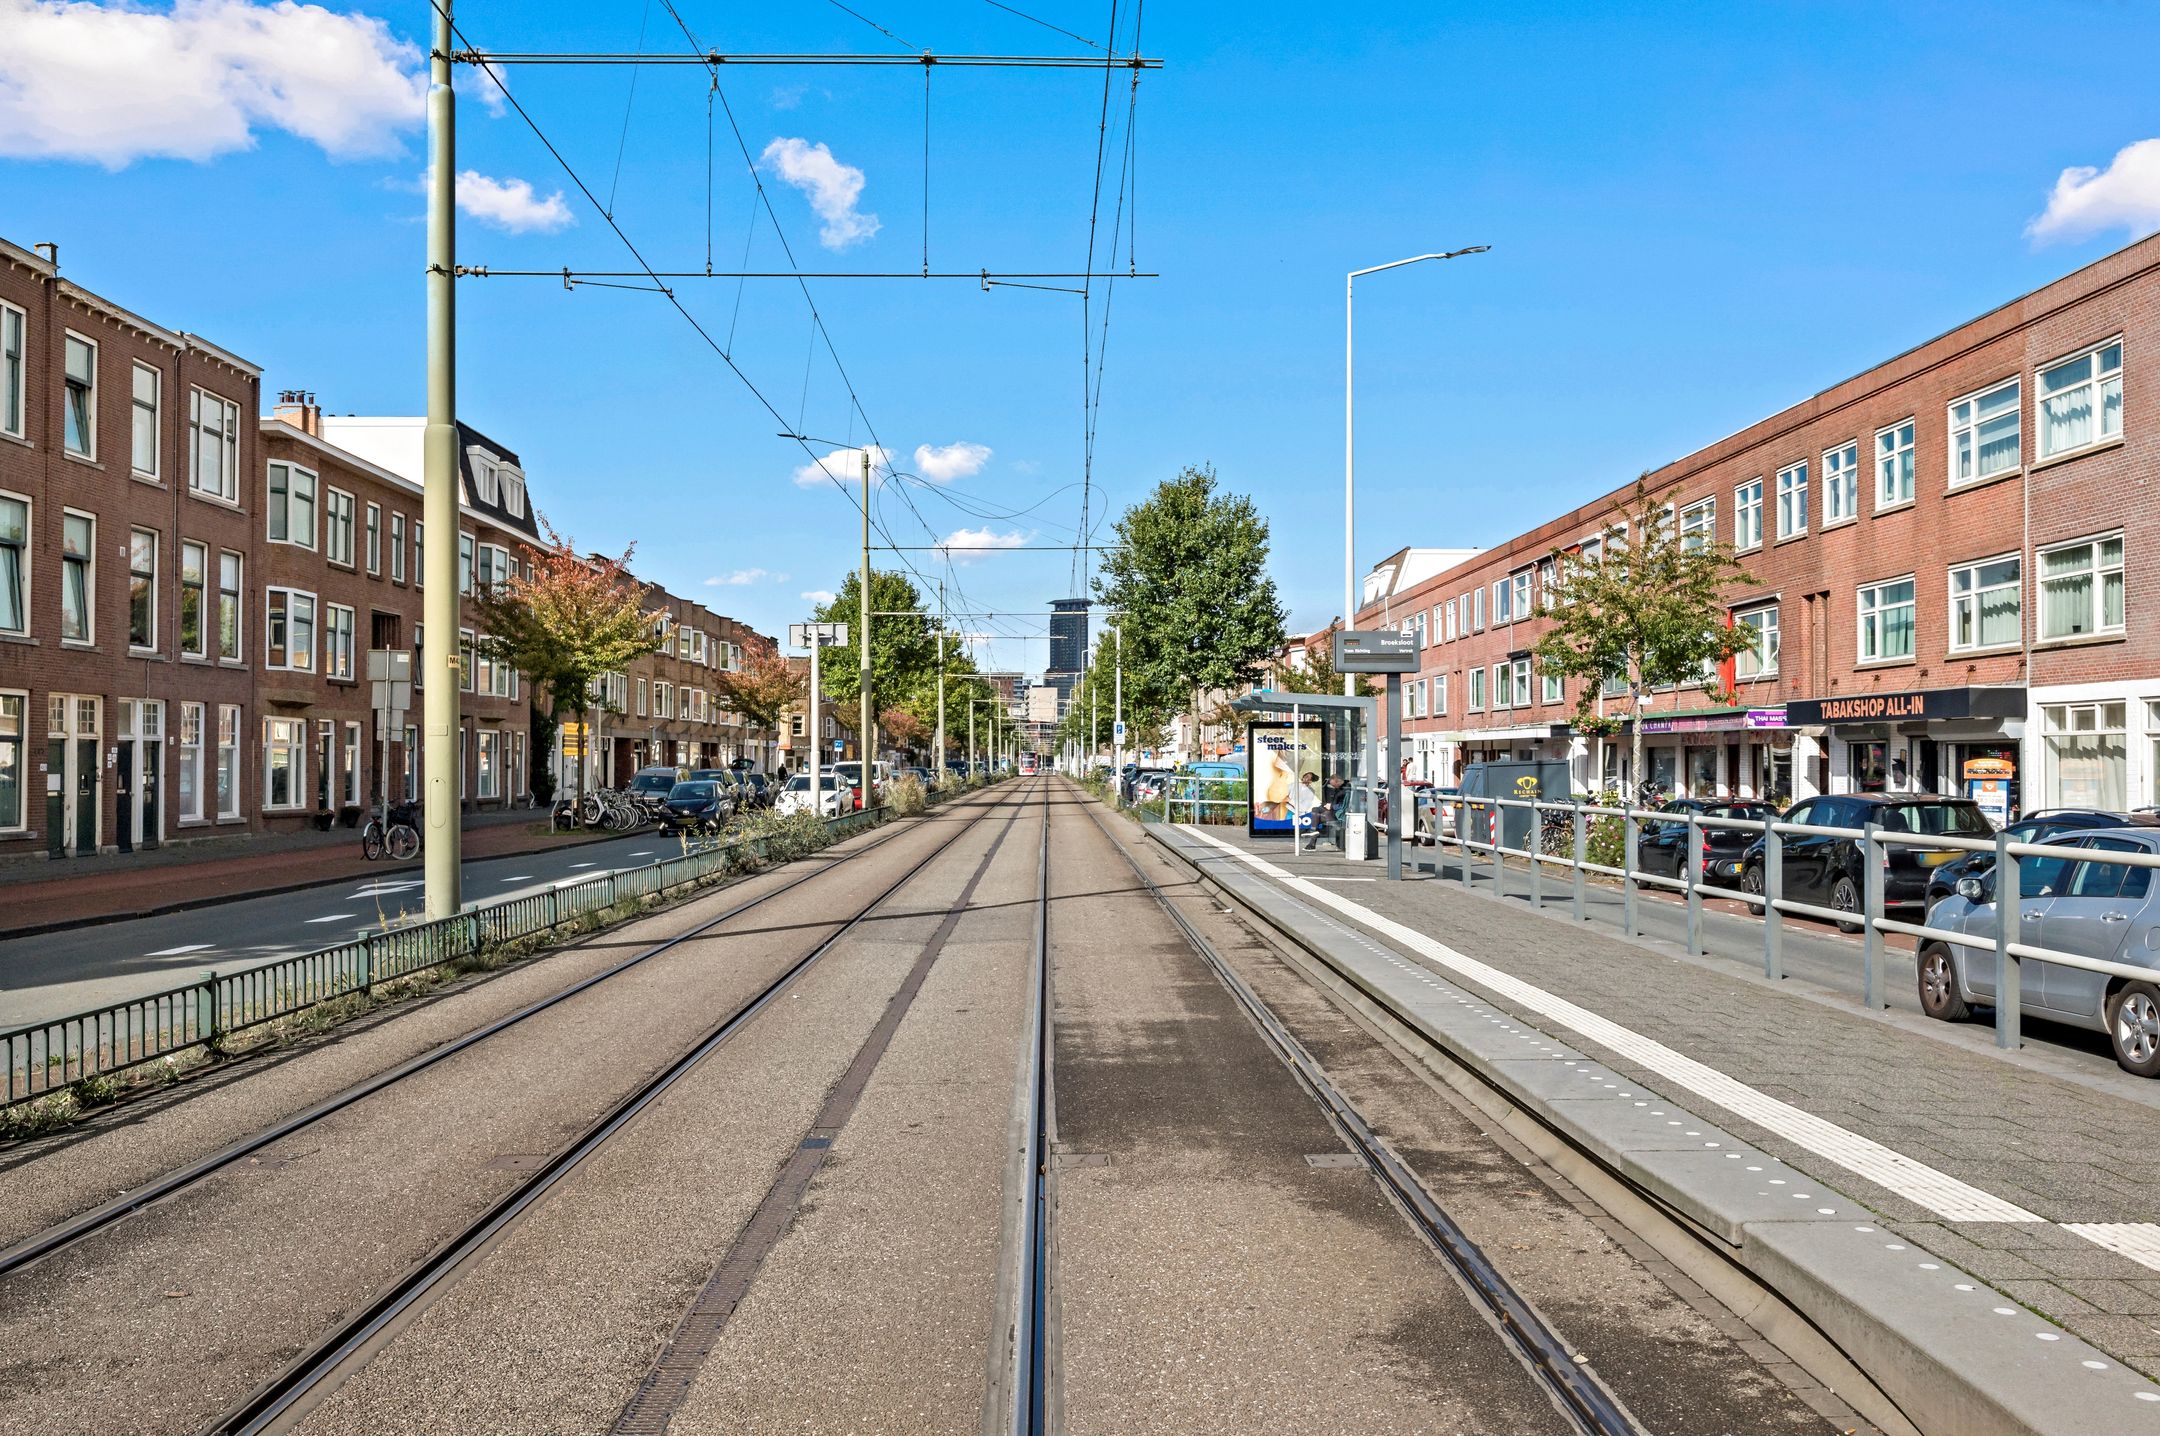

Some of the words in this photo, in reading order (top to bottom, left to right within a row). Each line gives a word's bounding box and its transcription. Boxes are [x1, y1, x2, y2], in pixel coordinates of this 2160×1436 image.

[1820, 698, 1885, 719] TABAKSHOP
[1886, 695, 1924, 716] ALL-IN
[1257, 735, 1285, 743] sfeer
